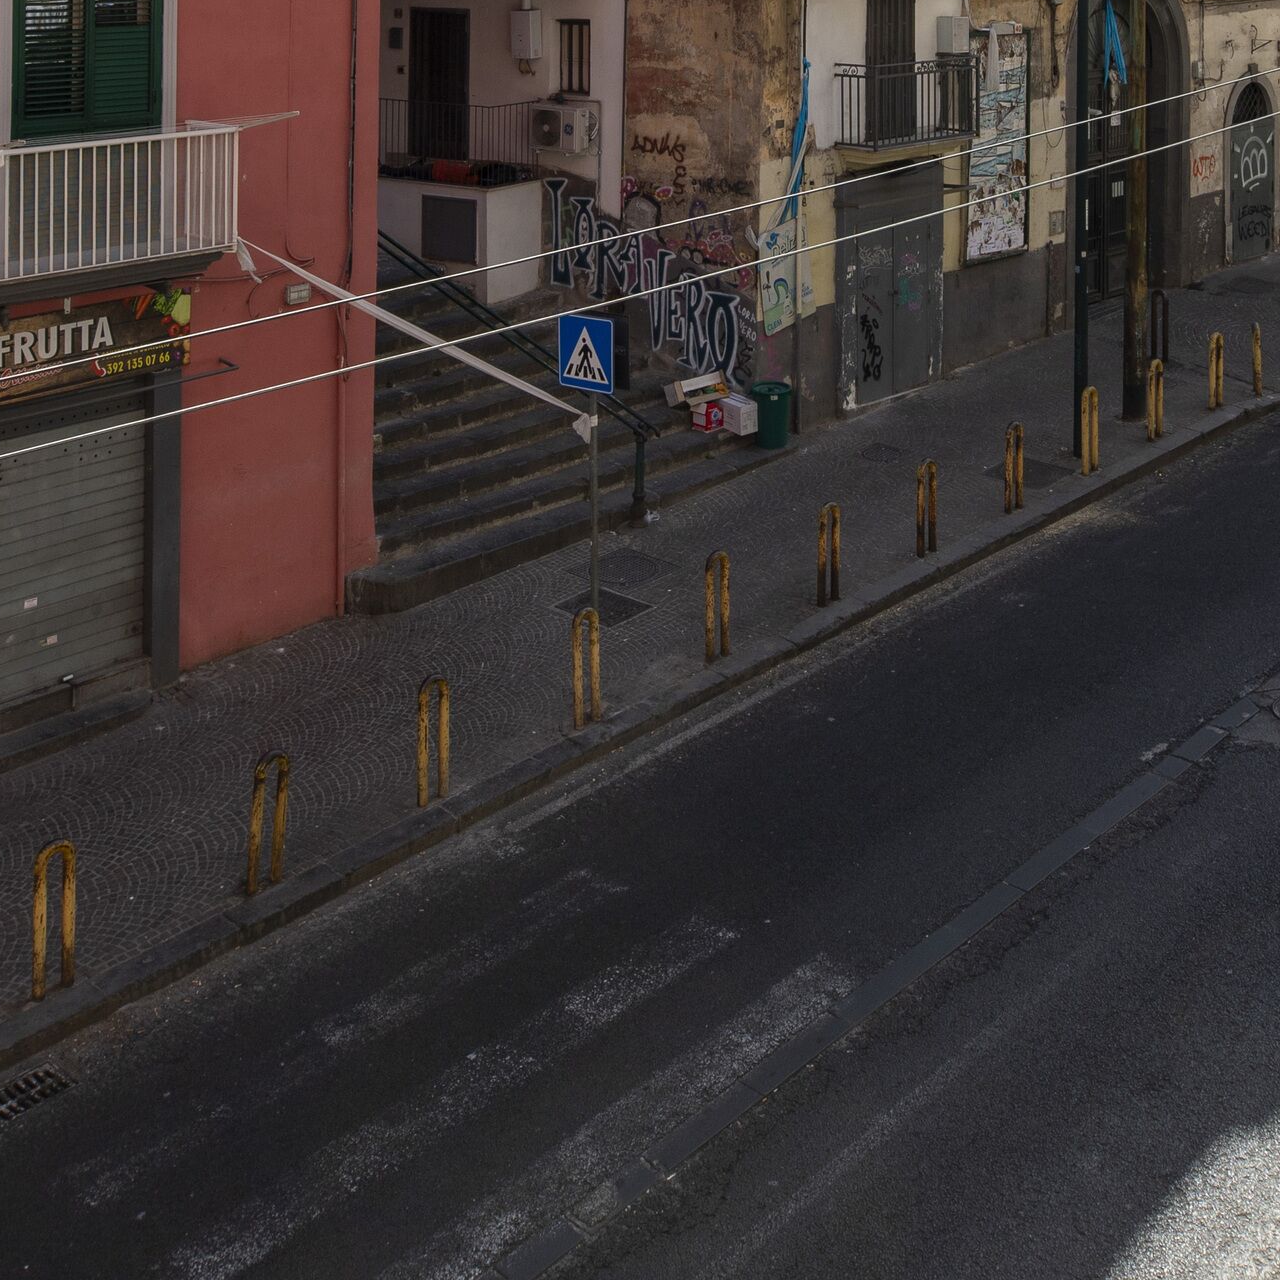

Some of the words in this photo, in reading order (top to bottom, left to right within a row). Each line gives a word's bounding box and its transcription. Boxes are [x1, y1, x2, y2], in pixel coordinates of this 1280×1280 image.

[106, 361, 124, 375] 392
[127, 358, 143, 370] 135
[145, 354, 157, 366] 07
[159, 351, 170, 363] 66
